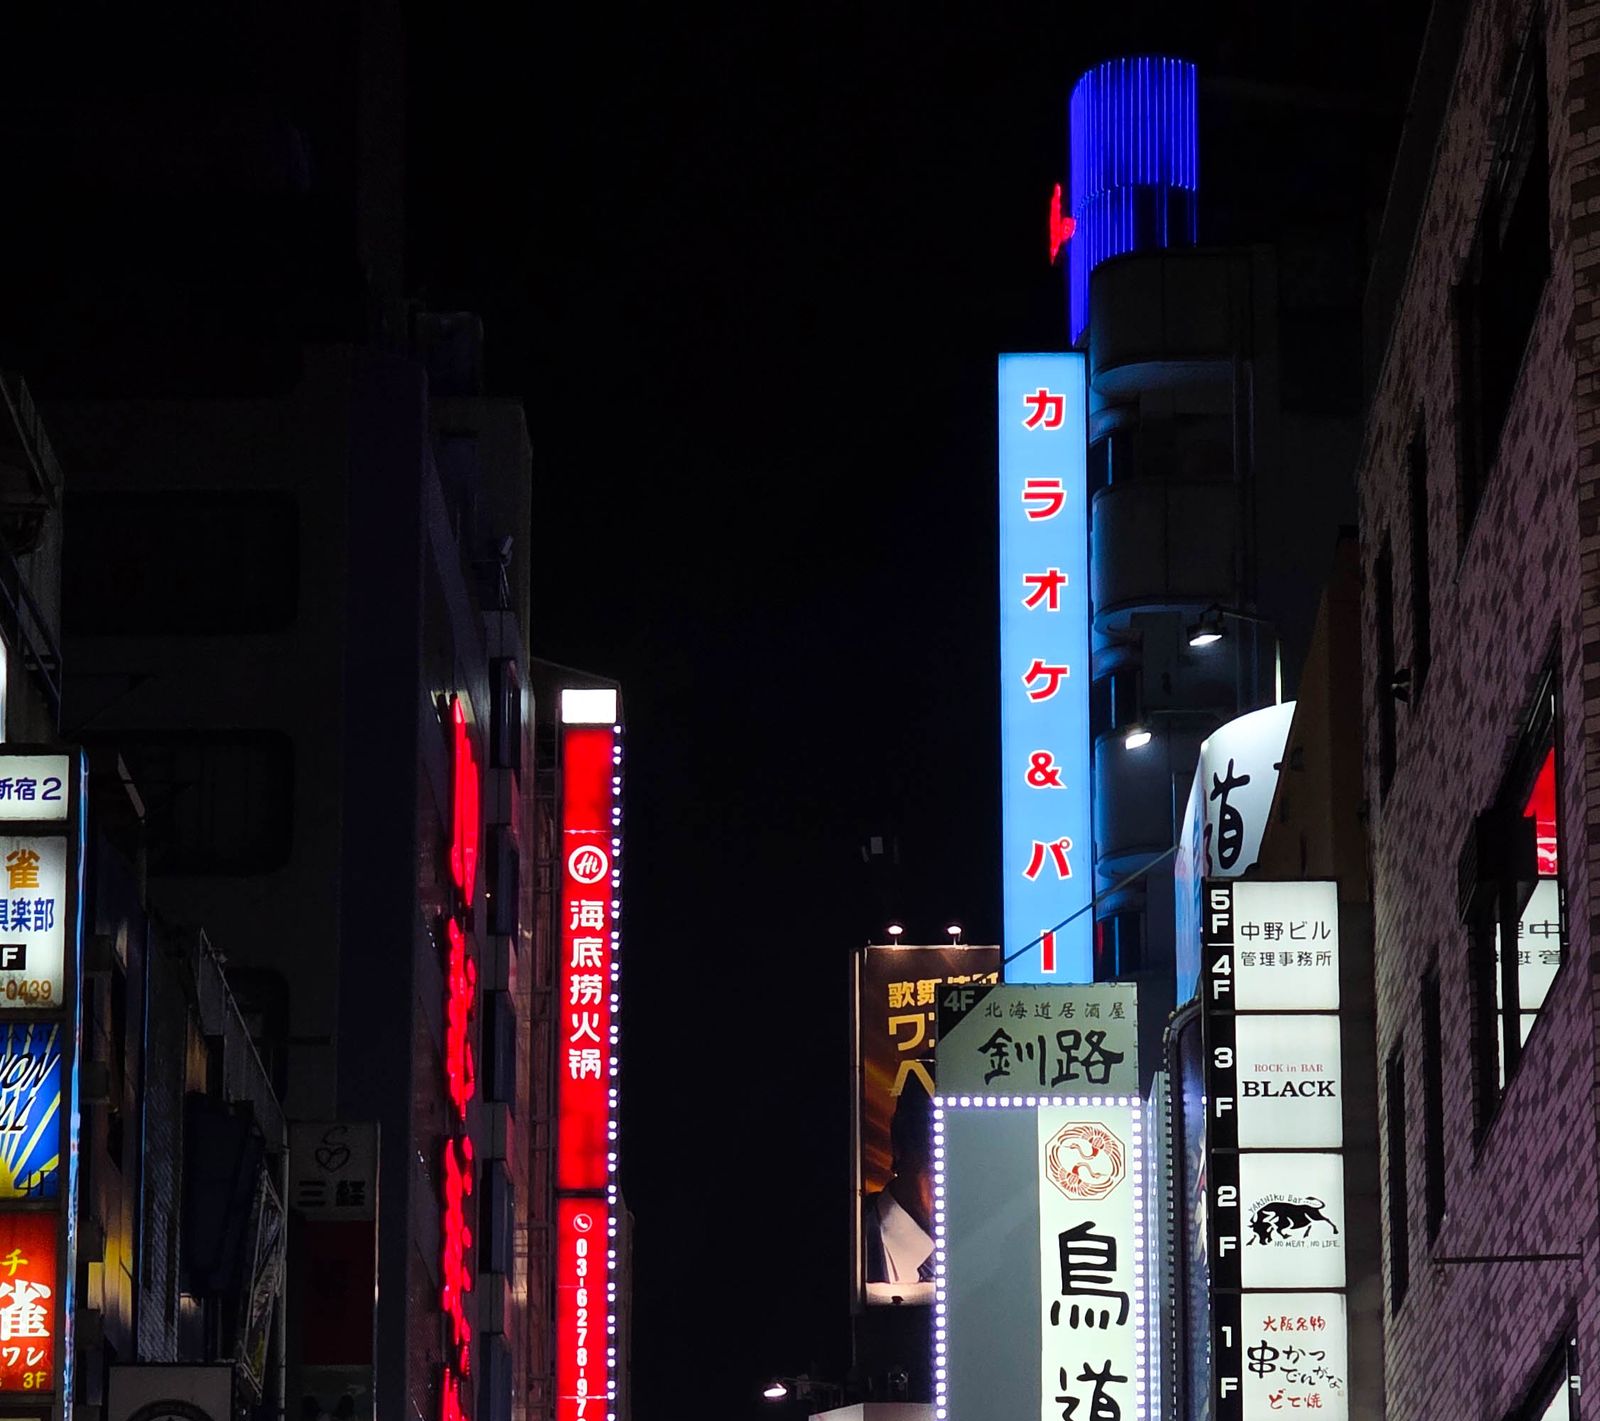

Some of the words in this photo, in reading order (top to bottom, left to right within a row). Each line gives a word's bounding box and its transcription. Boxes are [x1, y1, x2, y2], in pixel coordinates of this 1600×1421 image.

[7, 849, 40, 889] 雀
[1211, 889, 1231, 935] 5F
[1241, 921, 1331, 942] 中野ビル
[1241, 951, 1333, 967] 管理事務所
[1211, 955, 1231, 1000] 4F
[570, 901, 605, 1081] 海底捞火锅
[943, 991, 975, 1012] 4F
[984, 1001, 1126, 1020] 北海道居酒屋
[978, 1028, 1125, 1088] 釧路
[1254, 1064, 1284, 1073] ROCK
[1287, 1064, 1297, 1073] in
[1301, 1064, 1324, 1073] BAR
[1214, 1048, 1233, 1118] 3F
[1242, 1081, 1336, 1098] BLACK
[1249, 1194, 1285, 1213] YAKINIKU
[1217, 1187, 1237, 1257] 2F
[1274, 1240, 1284, 1248] NO
[1310, 1240, 1320, 1248] NO
[1263, 1316, 1326, 1332] 大阪名物
[1220, 1326, 1239, 1399] 1F
[24, 1373, 48, 1391] 3F
[1280, 1366, 1344, 1390] でんがな
[1268, 1387, 1323, 1409] どて焼
